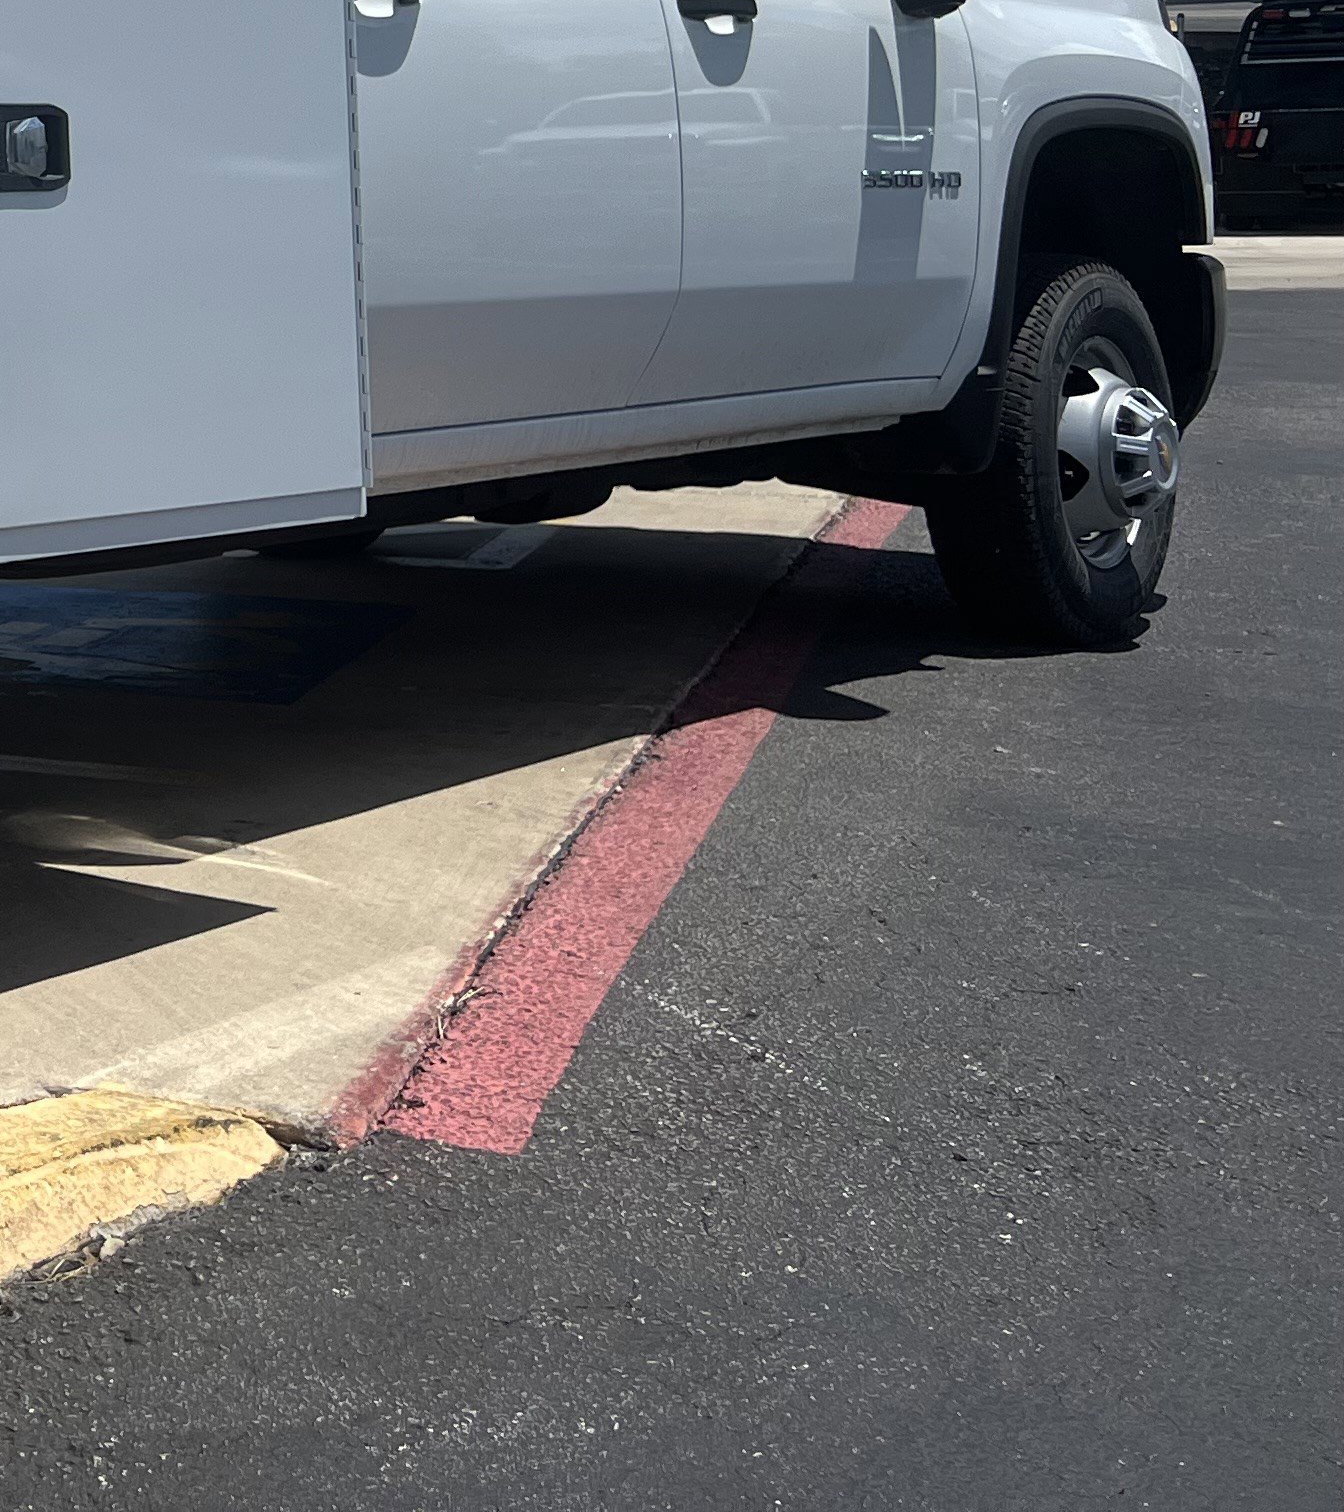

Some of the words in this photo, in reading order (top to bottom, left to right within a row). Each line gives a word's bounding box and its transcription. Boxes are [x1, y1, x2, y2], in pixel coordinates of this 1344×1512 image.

[1238, 111, 1261, 124] PJ
[928, 171, 961, 189] HD
[1058, 289, 1102, 360] MICHELIN
